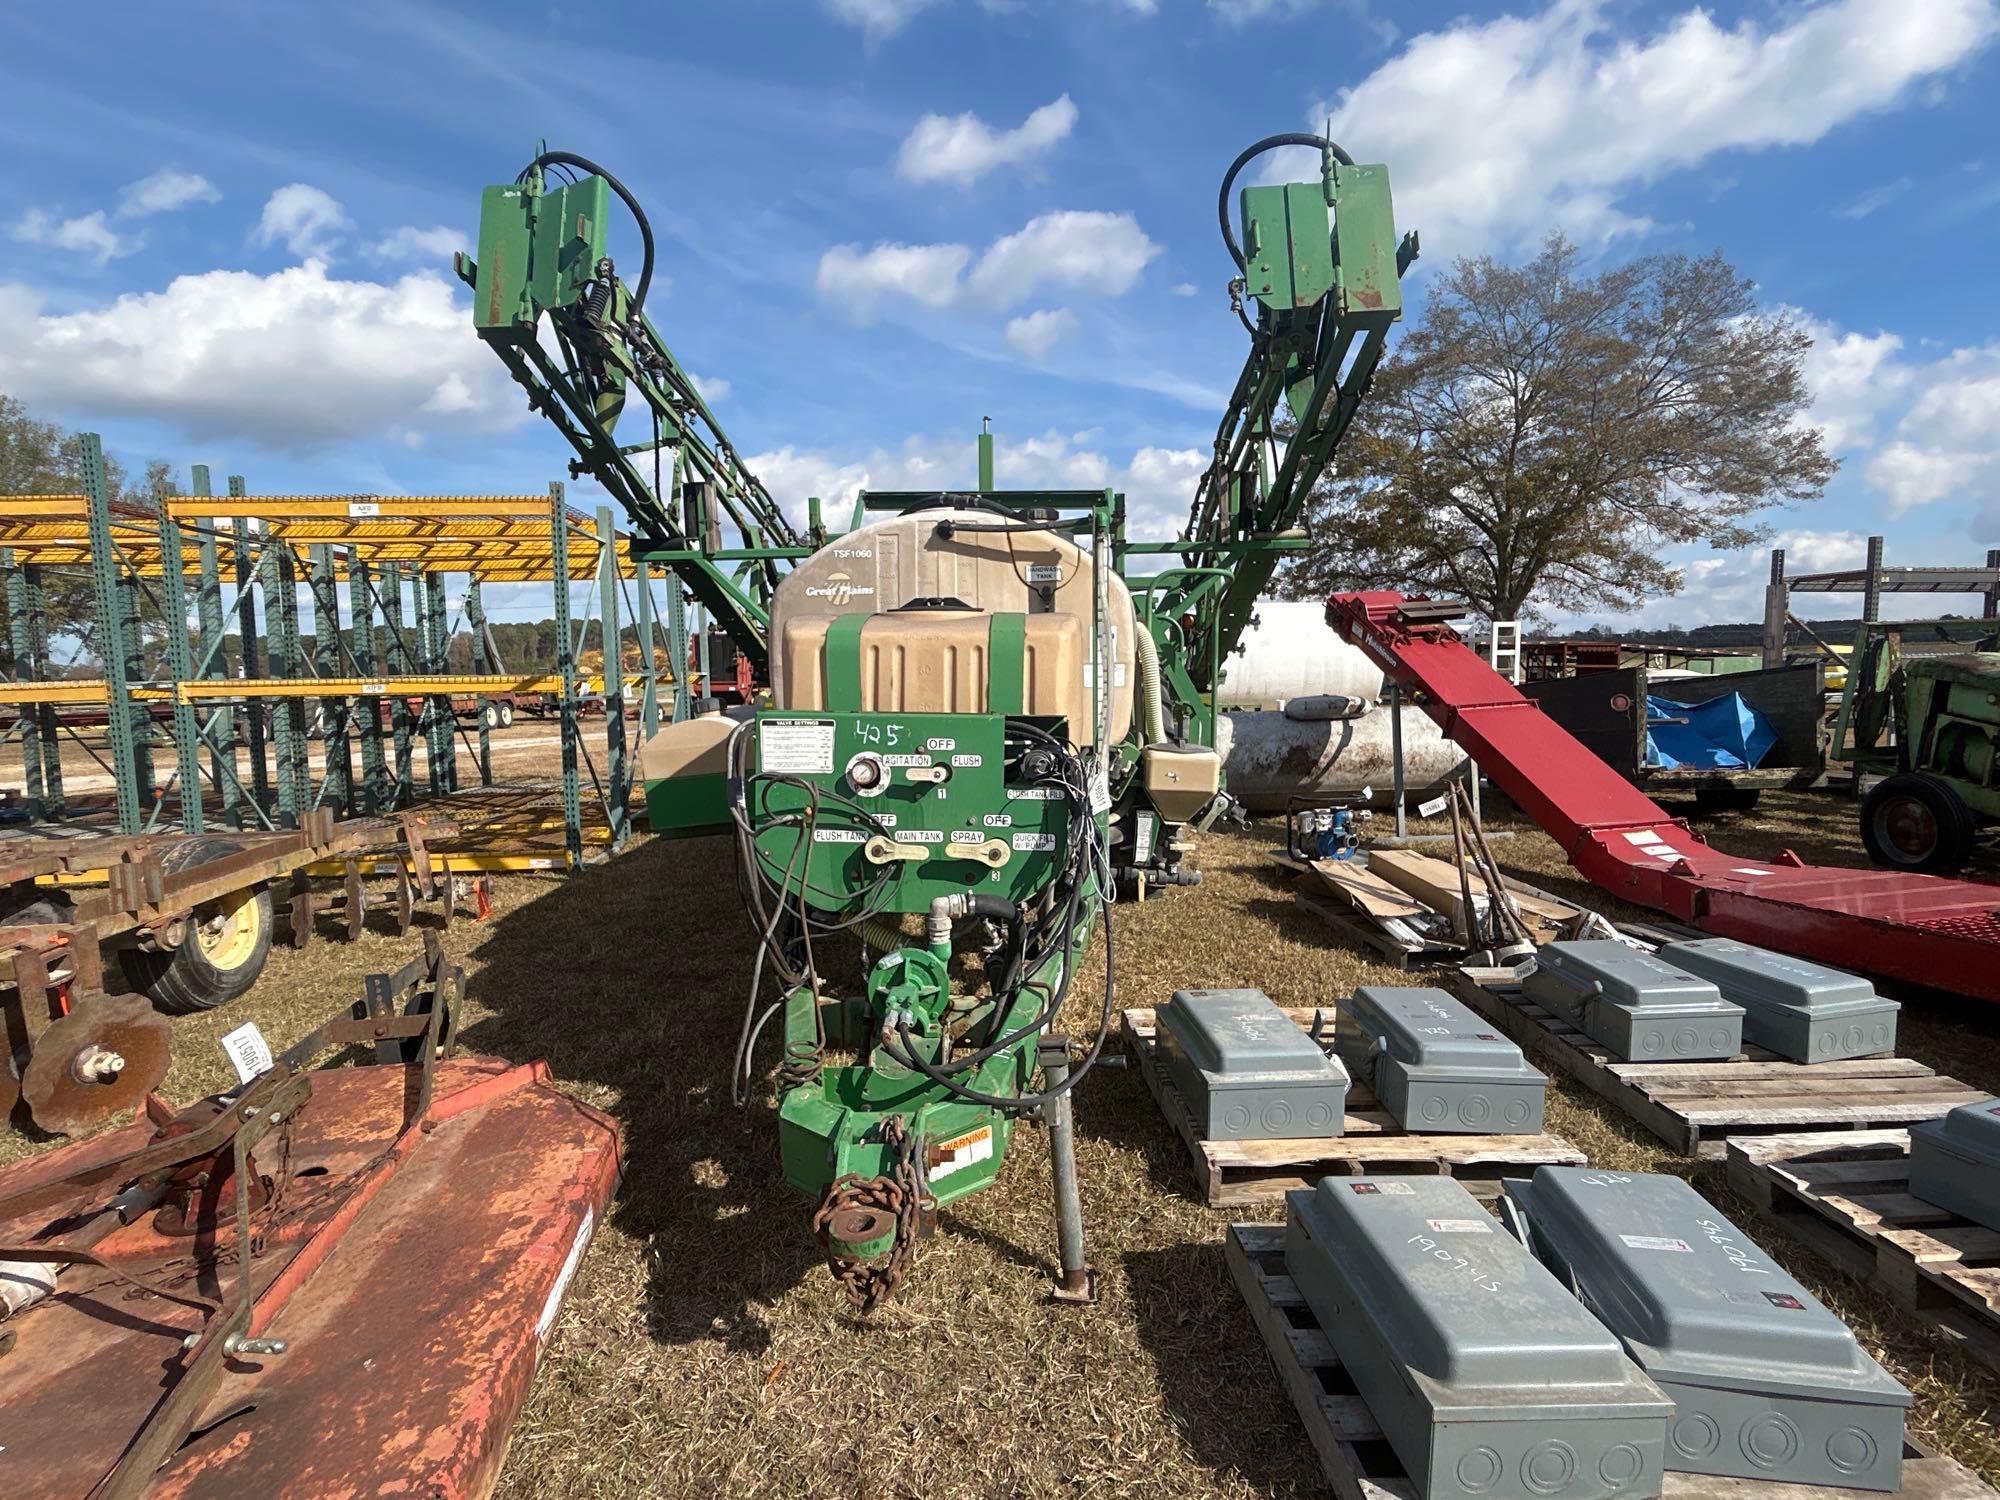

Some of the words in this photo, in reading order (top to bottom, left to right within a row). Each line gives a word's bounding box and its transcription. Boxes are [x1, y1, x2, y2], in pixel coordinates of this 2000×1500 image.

[833, 549, 873, 559] TSF1060
[805, 586, 837, 597] Great
[838, 584, 874, 596] Plains
[855, 719, 904, 747] 425
[928, 739, 954, 749] OFF
[884, 755, 930, 766] AGITATION
[953, 756, 980, 766] FLUSH
[1050, 790, 1064, 799] FILL
[985, 815, 1009, 825] OFF
[816, 831, 842, 841] FLUSH
[845, 831, 867, 841] TANK
[896, 831, 917, 841] MAIN
[919, 831, 942, 841] TANK
[952, 831, 983, 842] SPRAY
[1014, 834, 1036, 842] QUICK
[1038, 834, 1055, 843] FILL
[1025, 841, 1047, 849] PUMP
[992, 871, 999, 881] 3
[232, 1035, 261, 1071] 190517
[943, 1129, 989, 1151] WARNING
[1579, 1173, 1632, 1188] 426
[1696, 1218, 1770, 1275] 190945
[1407, 1234, 1502, 1293] 190945
